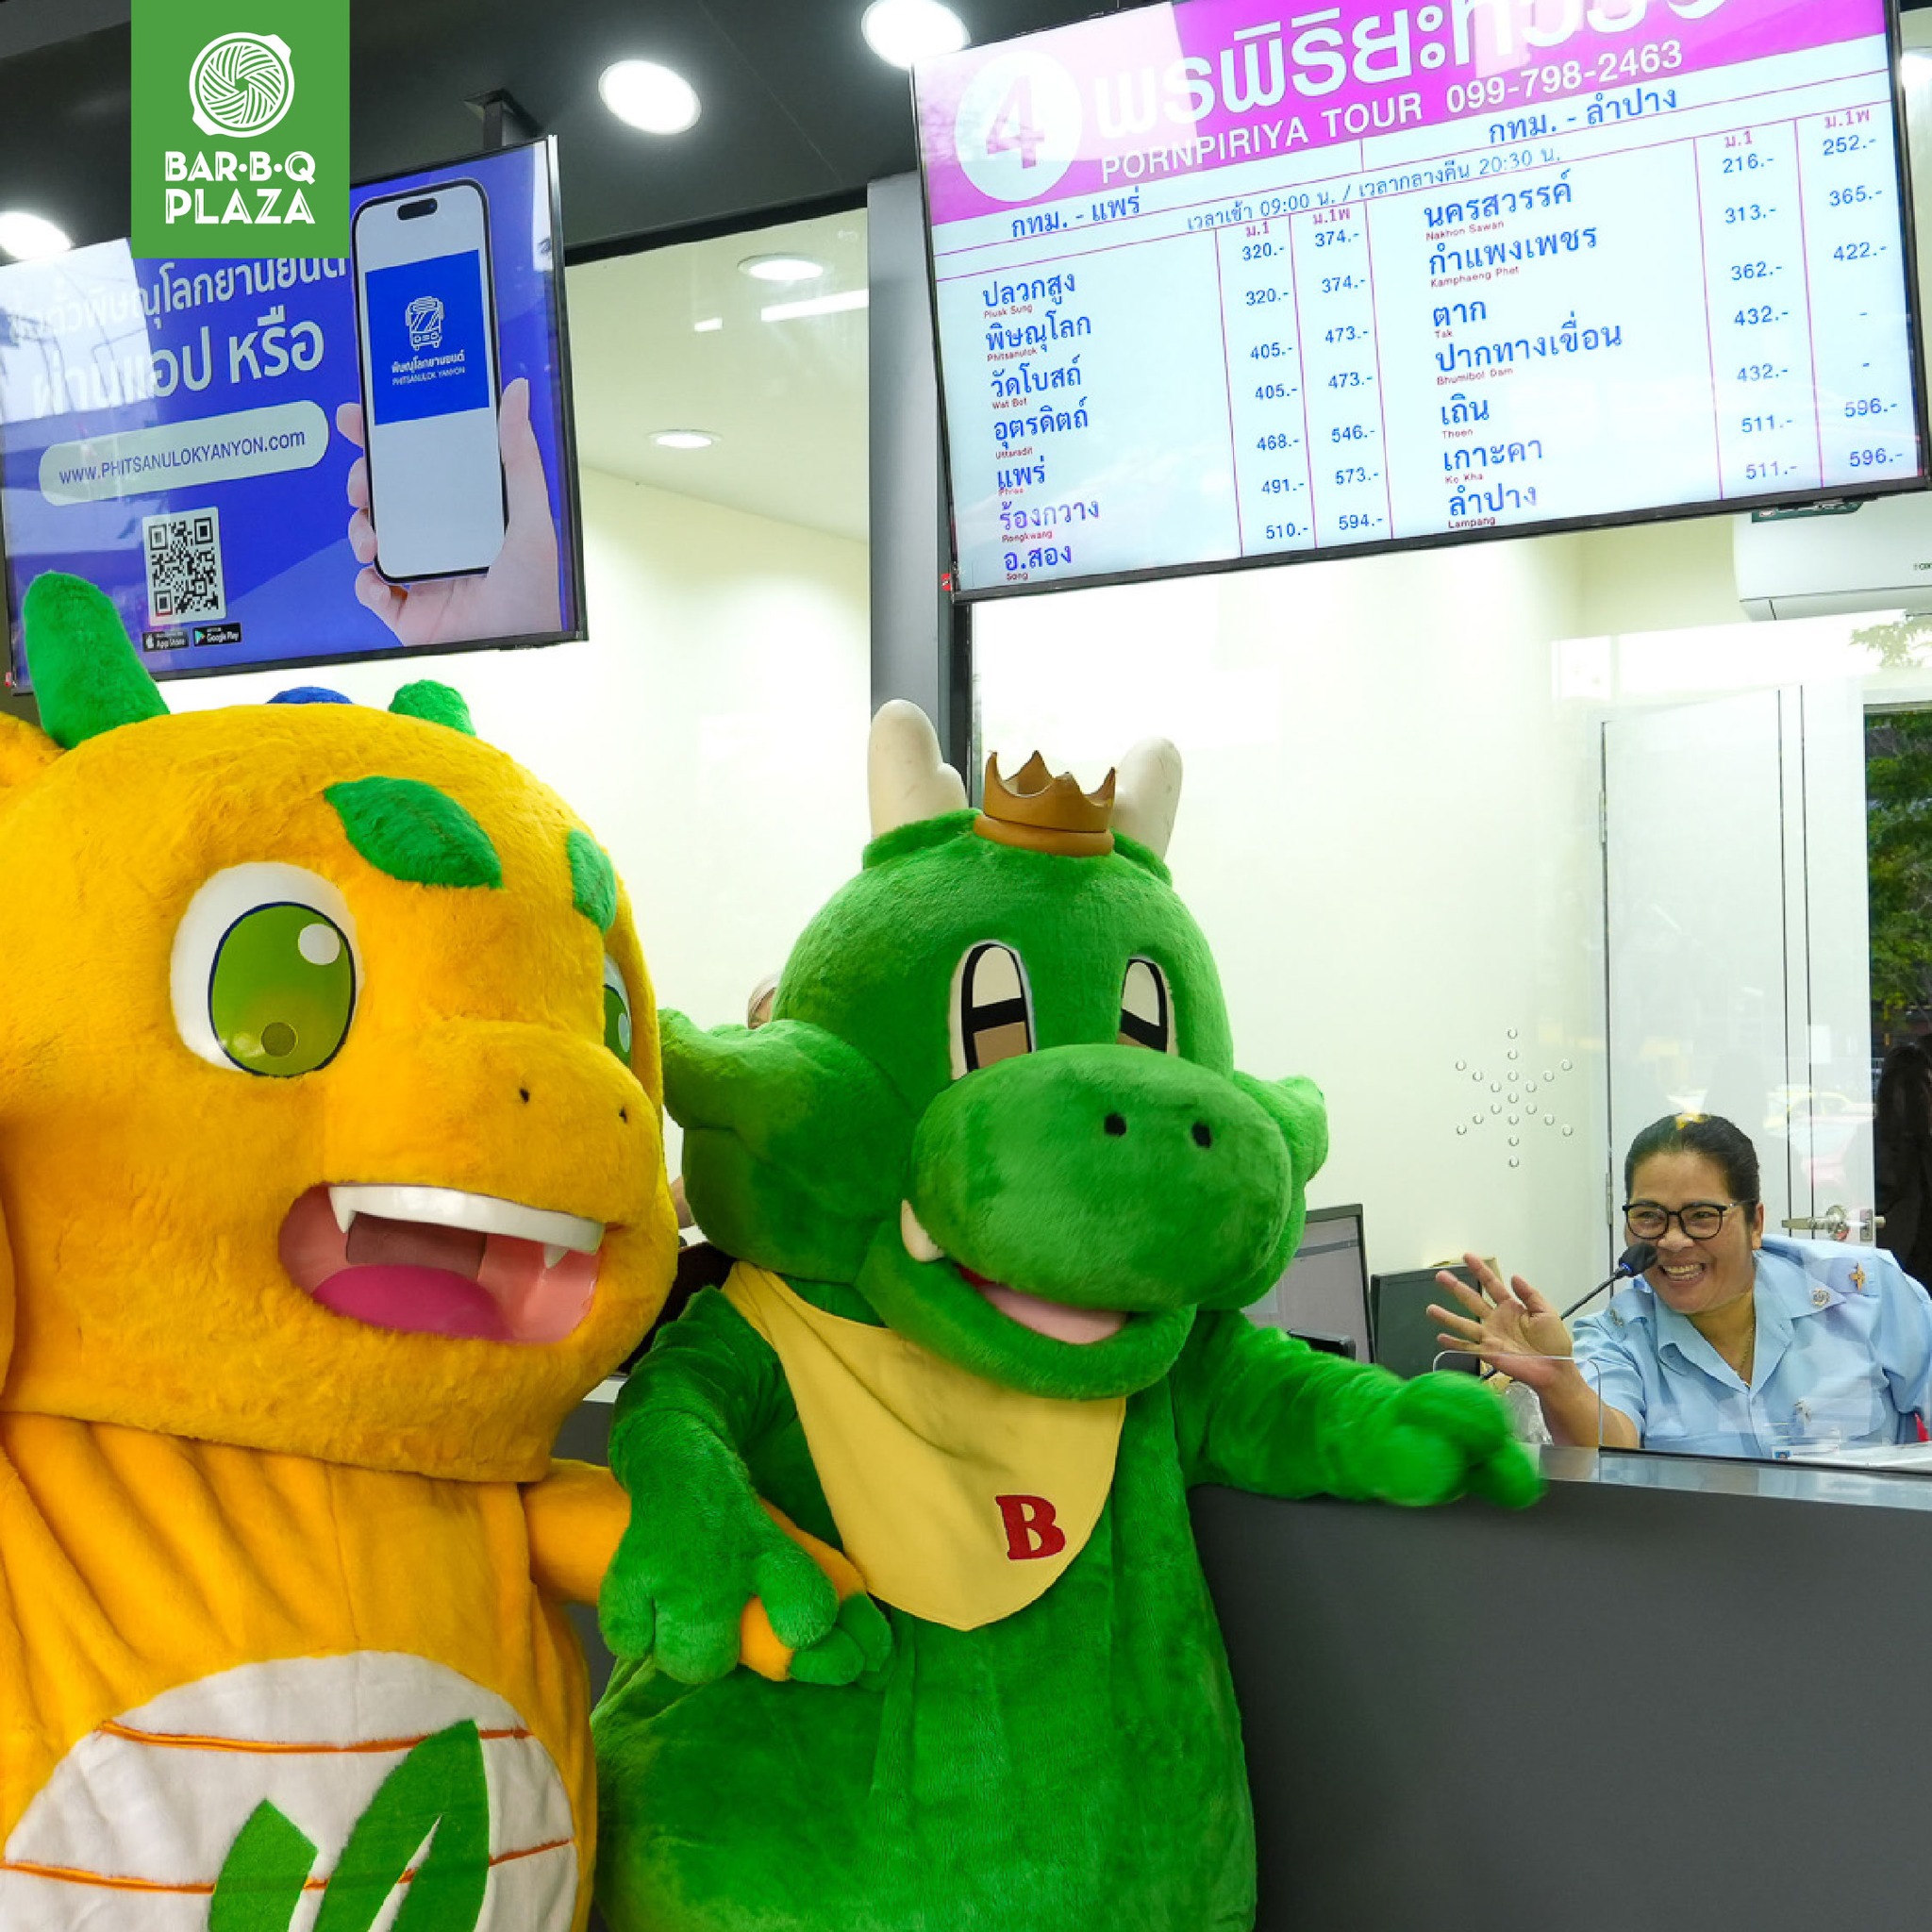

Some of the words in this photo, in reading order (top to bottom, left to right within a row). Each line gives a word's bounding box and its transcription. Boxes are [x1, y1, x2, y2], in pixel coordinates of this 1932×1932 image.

[986, 75, 1045, 169] 4
[1101, 115, 1309, 185] PORNPIRIYA
[1322, 92, 1423, 138] TOUR
[1445, 40, 1684, 113] 099-798-2463
[1489, 114, 1557, 143] กทม.
[1587, 88, 1678, 125] ลำปาง
[1724, 130, 1754, 148] ม.1
[1260, 193, 1310, 217] 09:00
[1317, 191, 1336, 206] น.
[1358, 159, 1470, 197] เวลากลางคืน
[1479, 150, 1533, 175] 20:30
[1541, 148, 1560, 162] น.
[1424, 168, 1572, 227] นครสวรรค์
[1011, 211, 1068, 238] กทม.
[1092, 185, 1140, 222] แพร่
[1246, 220, 1269, 237] ม.1
[1425, 227, 1465, 242] Nakhon
[1468, 220, 1505, 234] Sawan
[1429, 227, 1598, 275] กำแพงเพชร
[983, 274, 1075, 307] ปลวกสูง
[1431, 272, 1491, 288] Kamphaeng
[1495, 265, 1519, 277] Phet
[1433, 301, 1487, 327] ตาก
[228, 305, 325, 384] หรือ
[986, 310, 1091, 352] พิษณุโลก
[1435, 330, 1454, 339] Tak
[1435, 309, 1623, 372] ปากทางเขื่อน
[991, 353, 1081, 397] วัดโบสถ์
[1436, 371, 1486, 386] Bhumibol
[1491, 367, 1513, 377] Dam
[992, 400, 1009, 409] Wat
[1441, 392, 1490, 425] เถิน
[994, 396, 1089, 450] อุตรดิตถ์
[1442, 428, 1474, 439] Thoen
[59, 431, 305, 484] www.PHITSANULOKYANYON.com
[998, 455, 1045, 488] แพร่
[1444, 440, 1542, 471] เกาะคา
[1445, 475, 1458, 484] Ko
[1463, 473, 1484, 482] Kha
[1000, 500, 1099, 530] ร้องกวาง
[1449, 482, 1537, 516] ลำปาง
[1448, 517, 1495, 528] Lampang
[1004, 545, 1072, 571] อ.สอง
[1007, 572, 1028, 581] Song
[995, 1494, 1066, 1560] B
